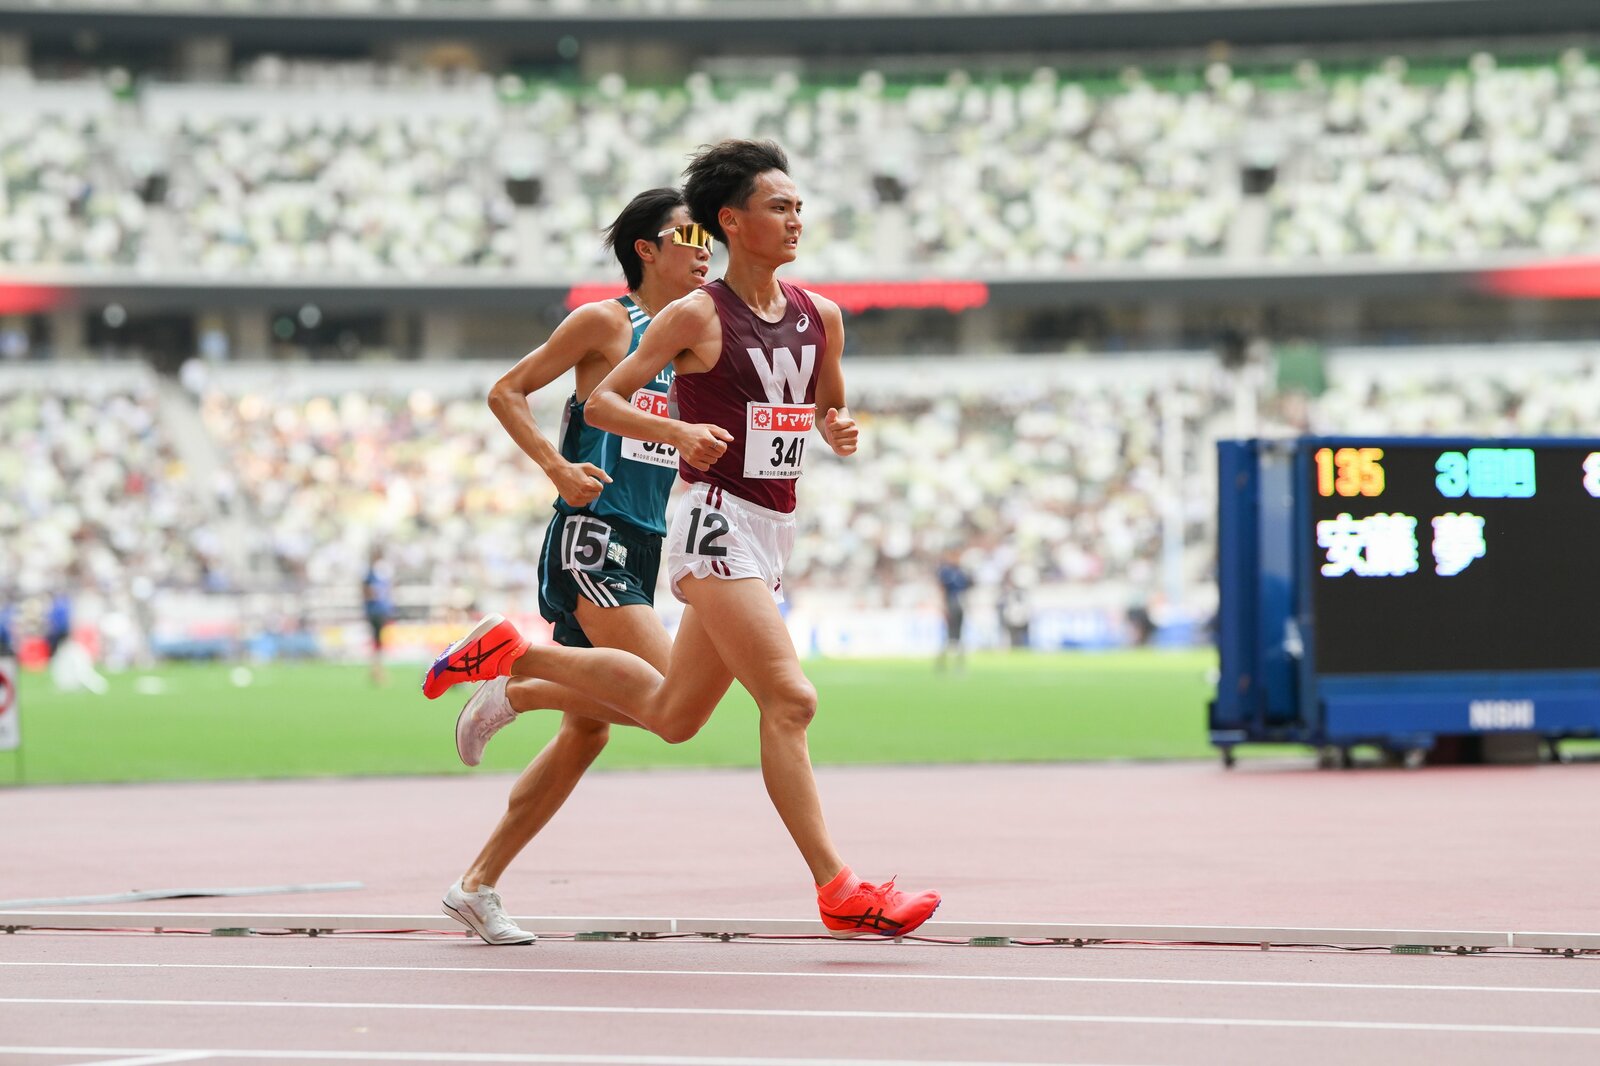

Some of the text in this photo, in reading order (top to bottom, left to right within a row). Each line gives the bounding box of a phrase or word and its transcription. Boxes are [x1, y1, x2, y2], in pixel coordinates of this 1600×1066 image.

[746, 344, 817, 404] W
[770, 436, 805, 467] 341
[1315, 447, 1386, 497] 135
[565, 521, 608, 566] 15
[685, 507, 730, 557] 12
